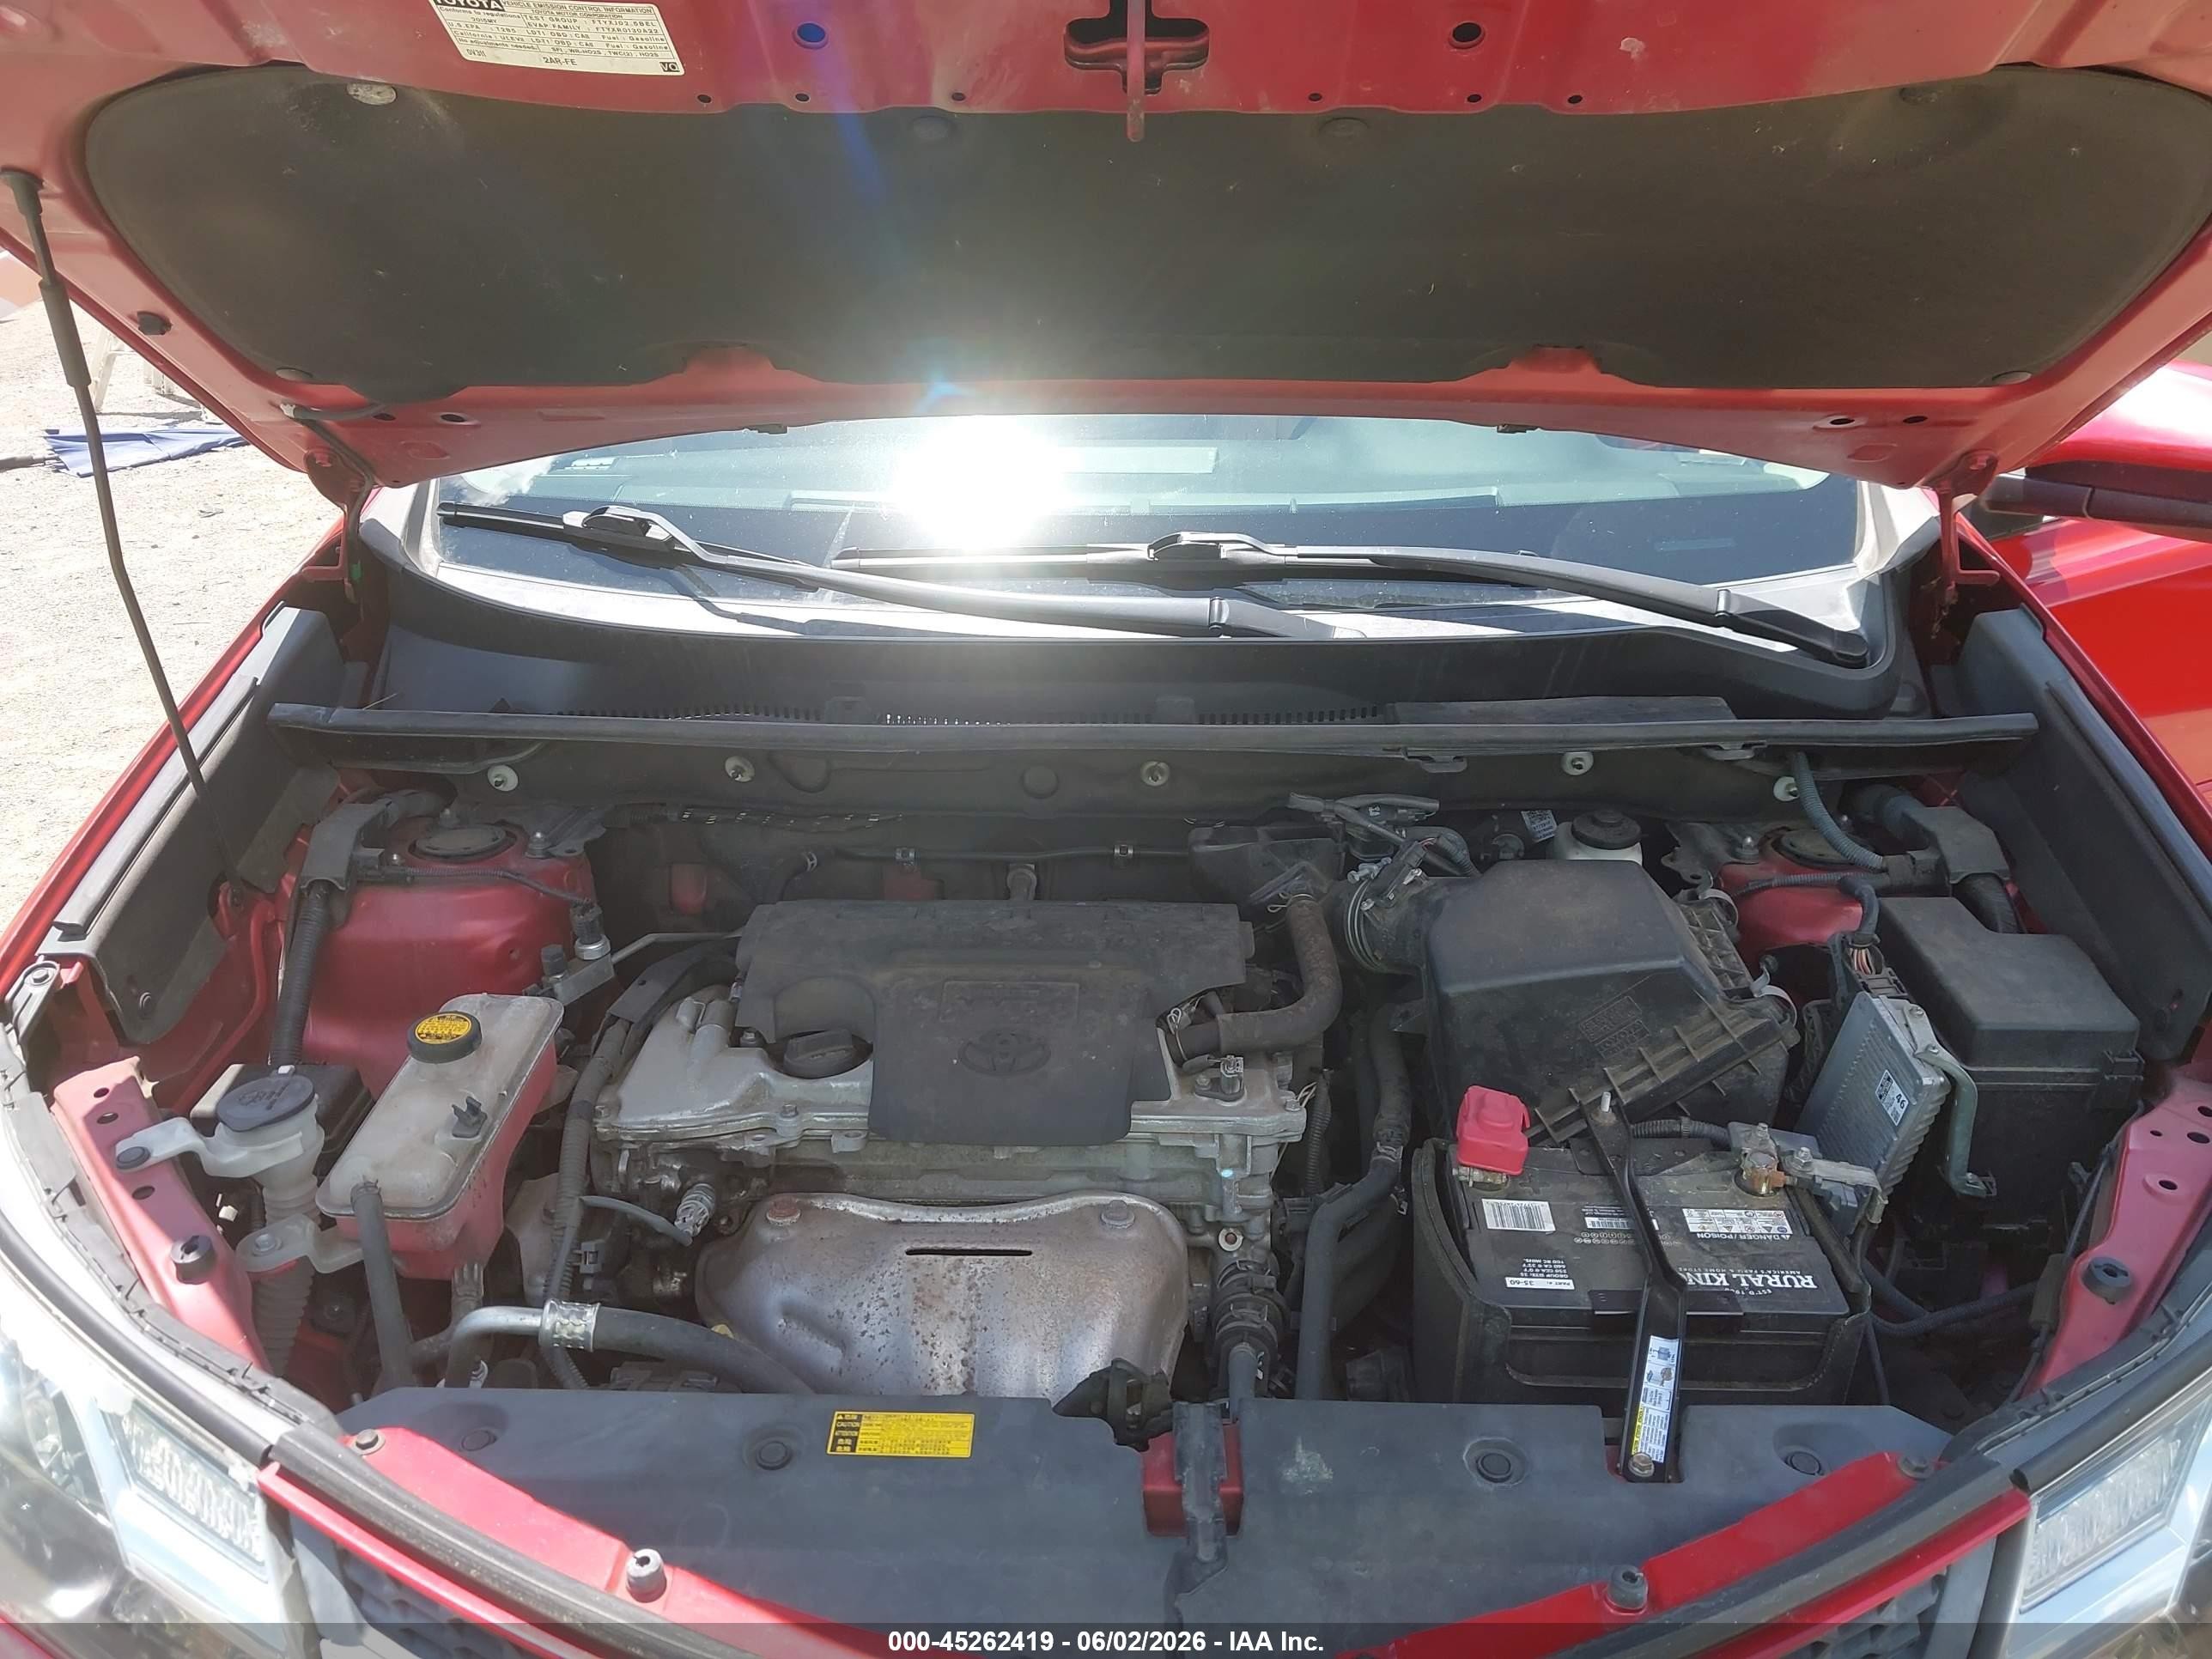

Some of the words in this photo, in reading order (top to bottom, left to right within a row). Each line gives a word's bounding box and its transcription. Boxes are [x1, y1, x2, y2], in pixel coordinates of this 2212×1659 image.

[532, 2, 567, 10] EMISSION
[483, 11, 522, 20] regulations
[543, 56, 578, 66] 2AR-FE
[1895, 1093, 1906, 1109] 46
[1732, 1273, 1818, 1289] RURAL
